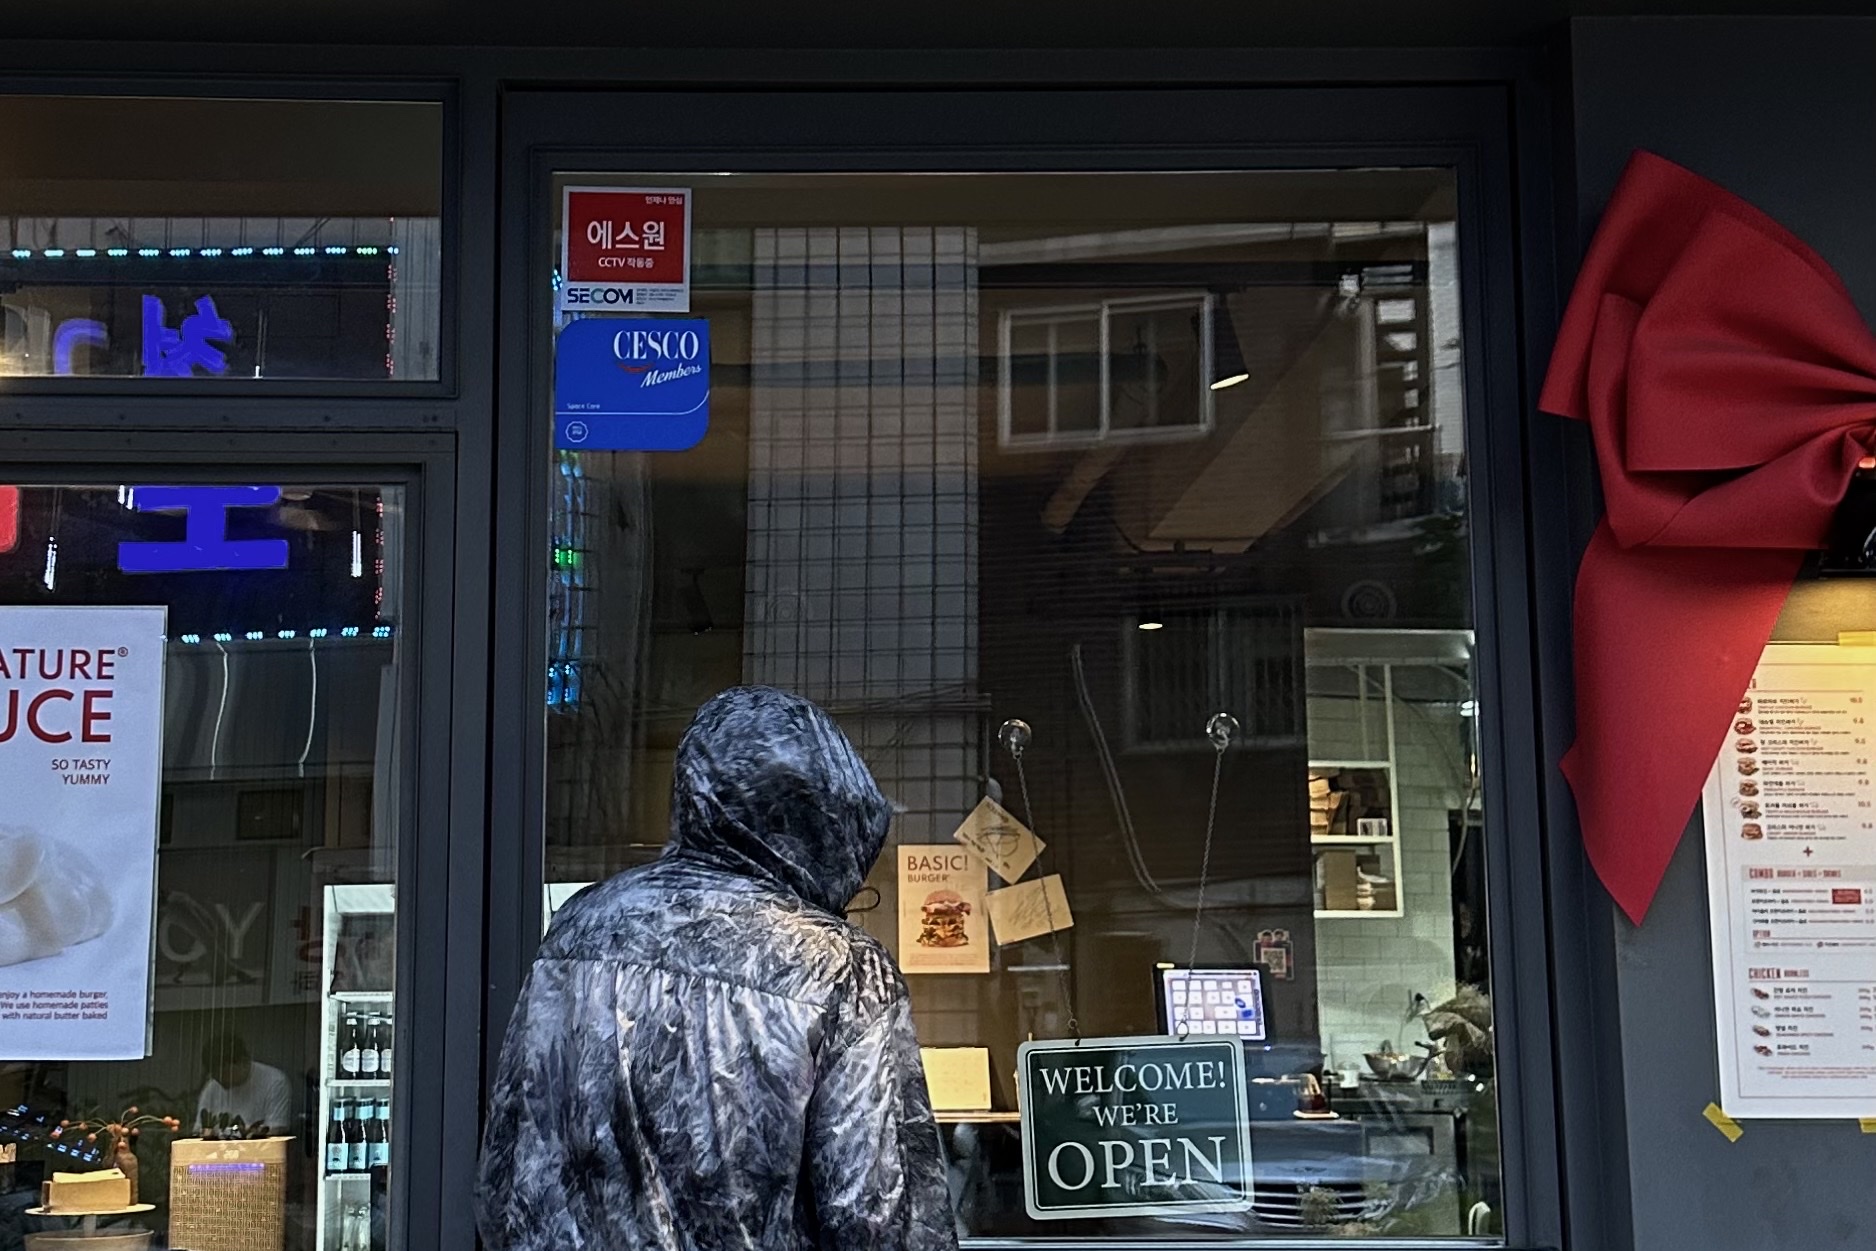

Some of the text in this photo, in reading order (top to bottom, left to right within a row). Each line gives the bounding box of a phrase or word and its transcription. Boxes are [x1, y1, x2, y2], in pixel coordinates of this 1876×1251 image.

[587, 221, 665, 250] 에스원
[598, 257, 625, 268] CCTV
[567, 288, 634, 304] SECOM
[613, 330, 699, 360] CESCO
[640, 363, 702, 388] Members
[51, 759, 111, 771] SO TASTY
[62, 774, 110, 785] YUMMY
[907, 855, 968, 872] BASIC!
[907, 873, 948, 883] BURGER
[30, 990, 77, 999] homemade
[16, 1002, 30, 1010] use
[32, 1001, 79, 1010] homemade
[80, 1001, 109, 1011] patties
[2, 1011, 108, 1020] with natural butter baked
[1040, 1061, 1226, 1095] WELCOME!
[1092, 1103, 1179, 1127] WE’RE
[1048, 1136, 1227, 1191] OPEN
